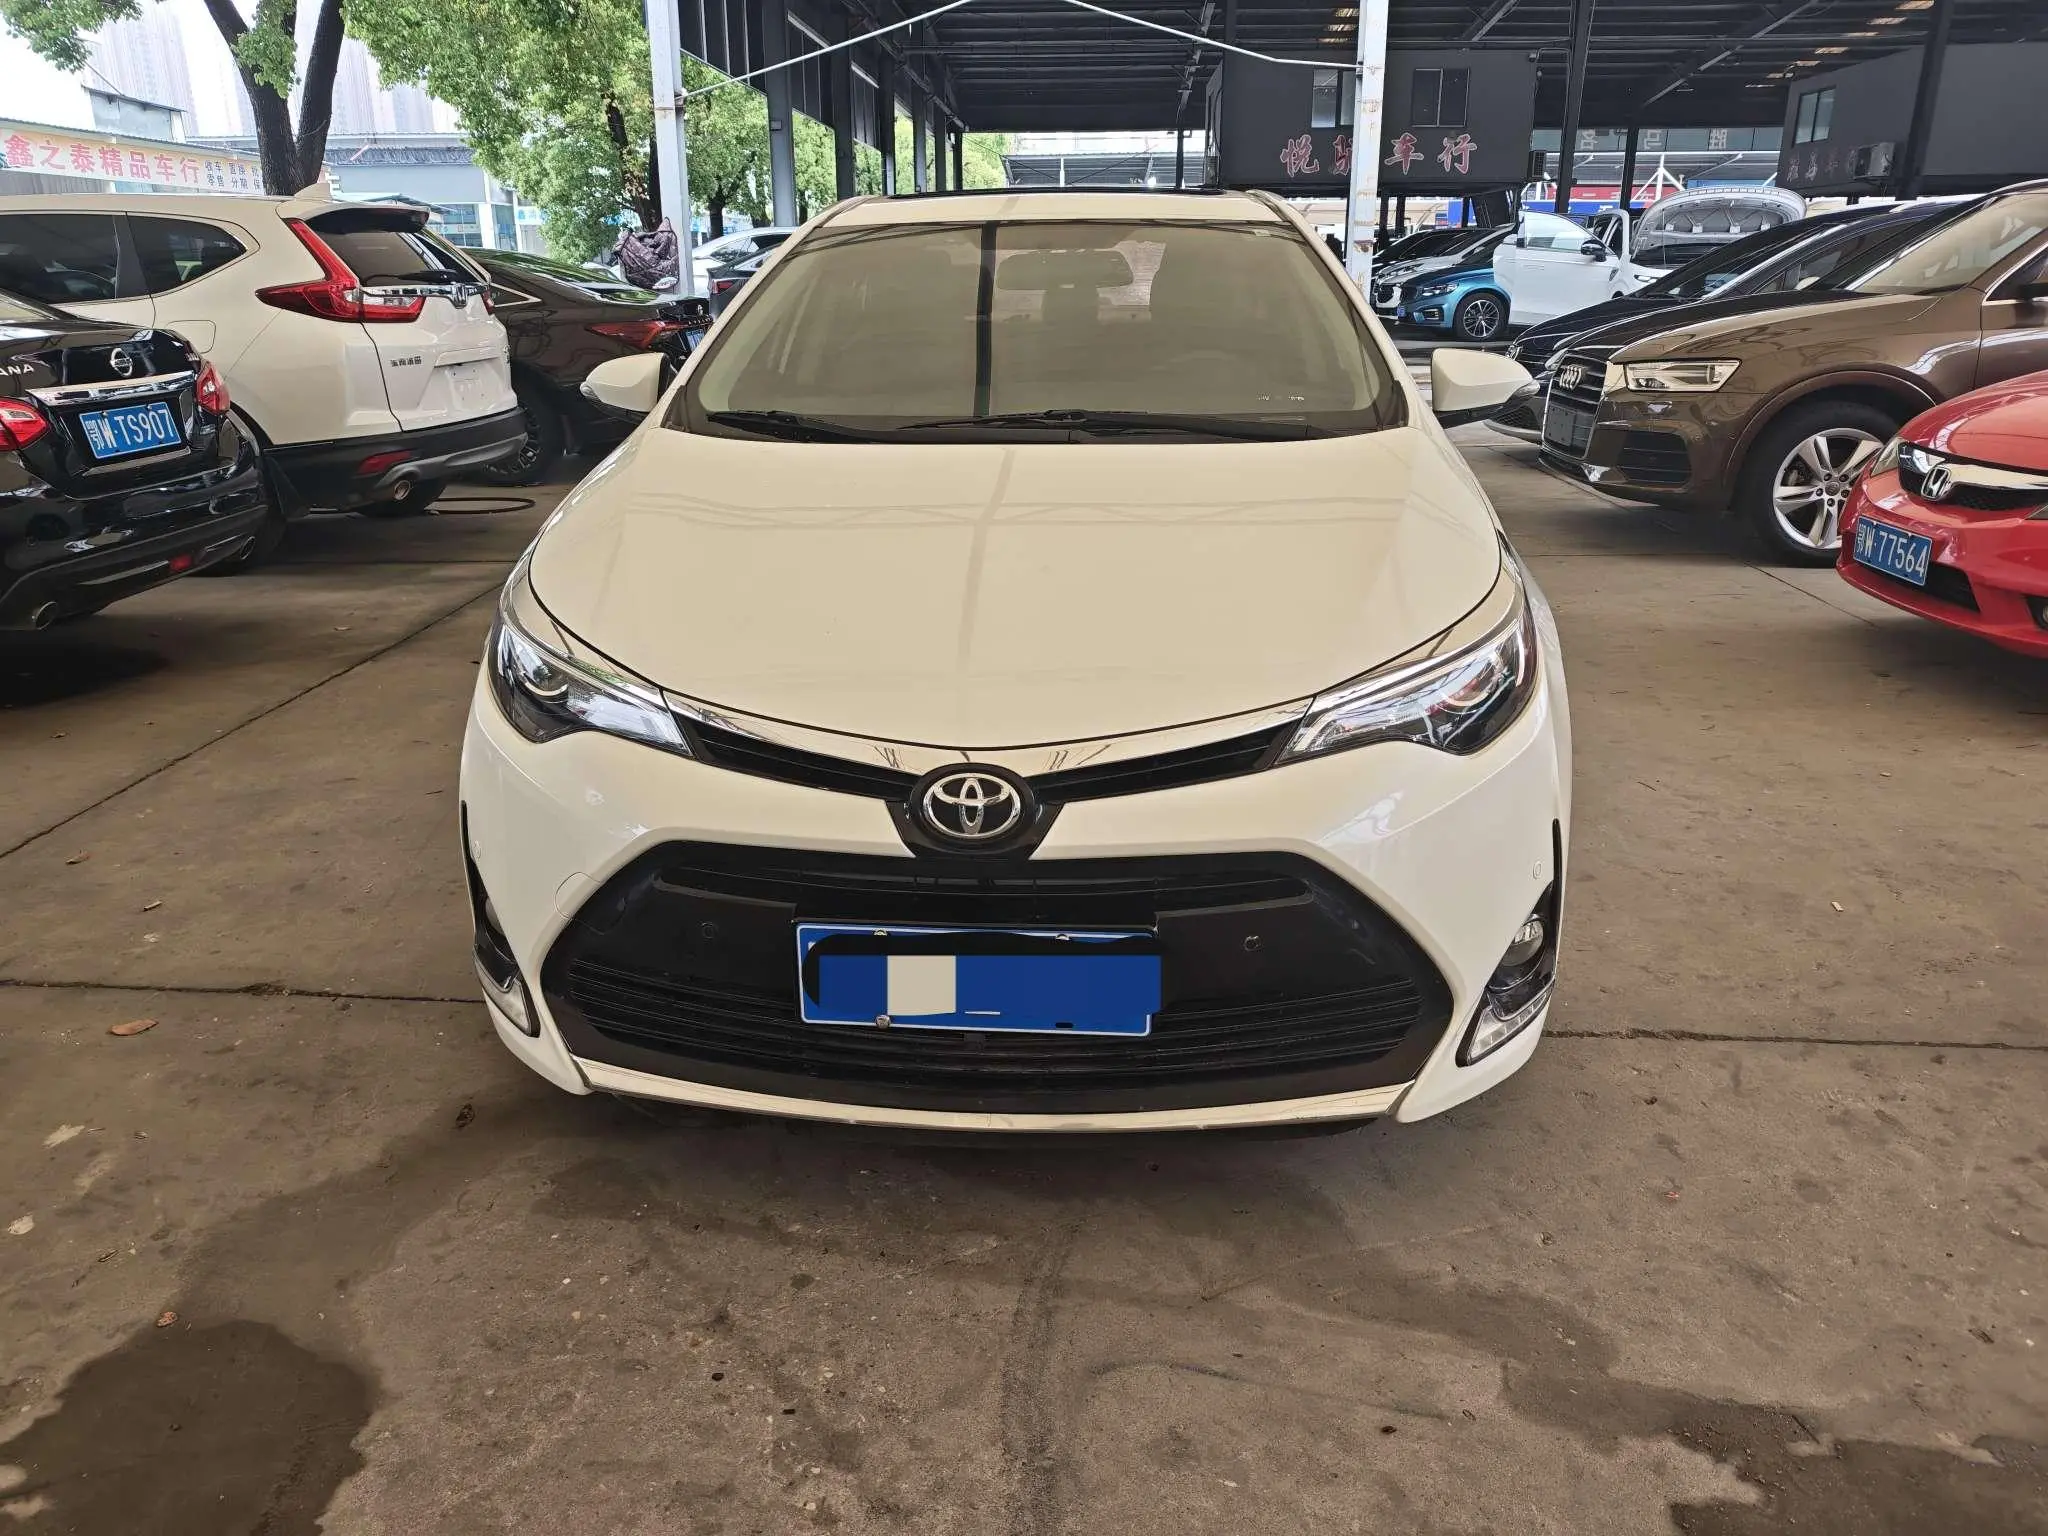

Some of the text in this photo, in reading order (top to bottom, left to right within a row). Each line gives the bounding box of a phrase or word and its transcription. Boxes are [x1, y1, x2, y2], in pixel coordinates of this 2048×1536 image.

[4, 134, 200, 183] 鑫之泰精品车行
